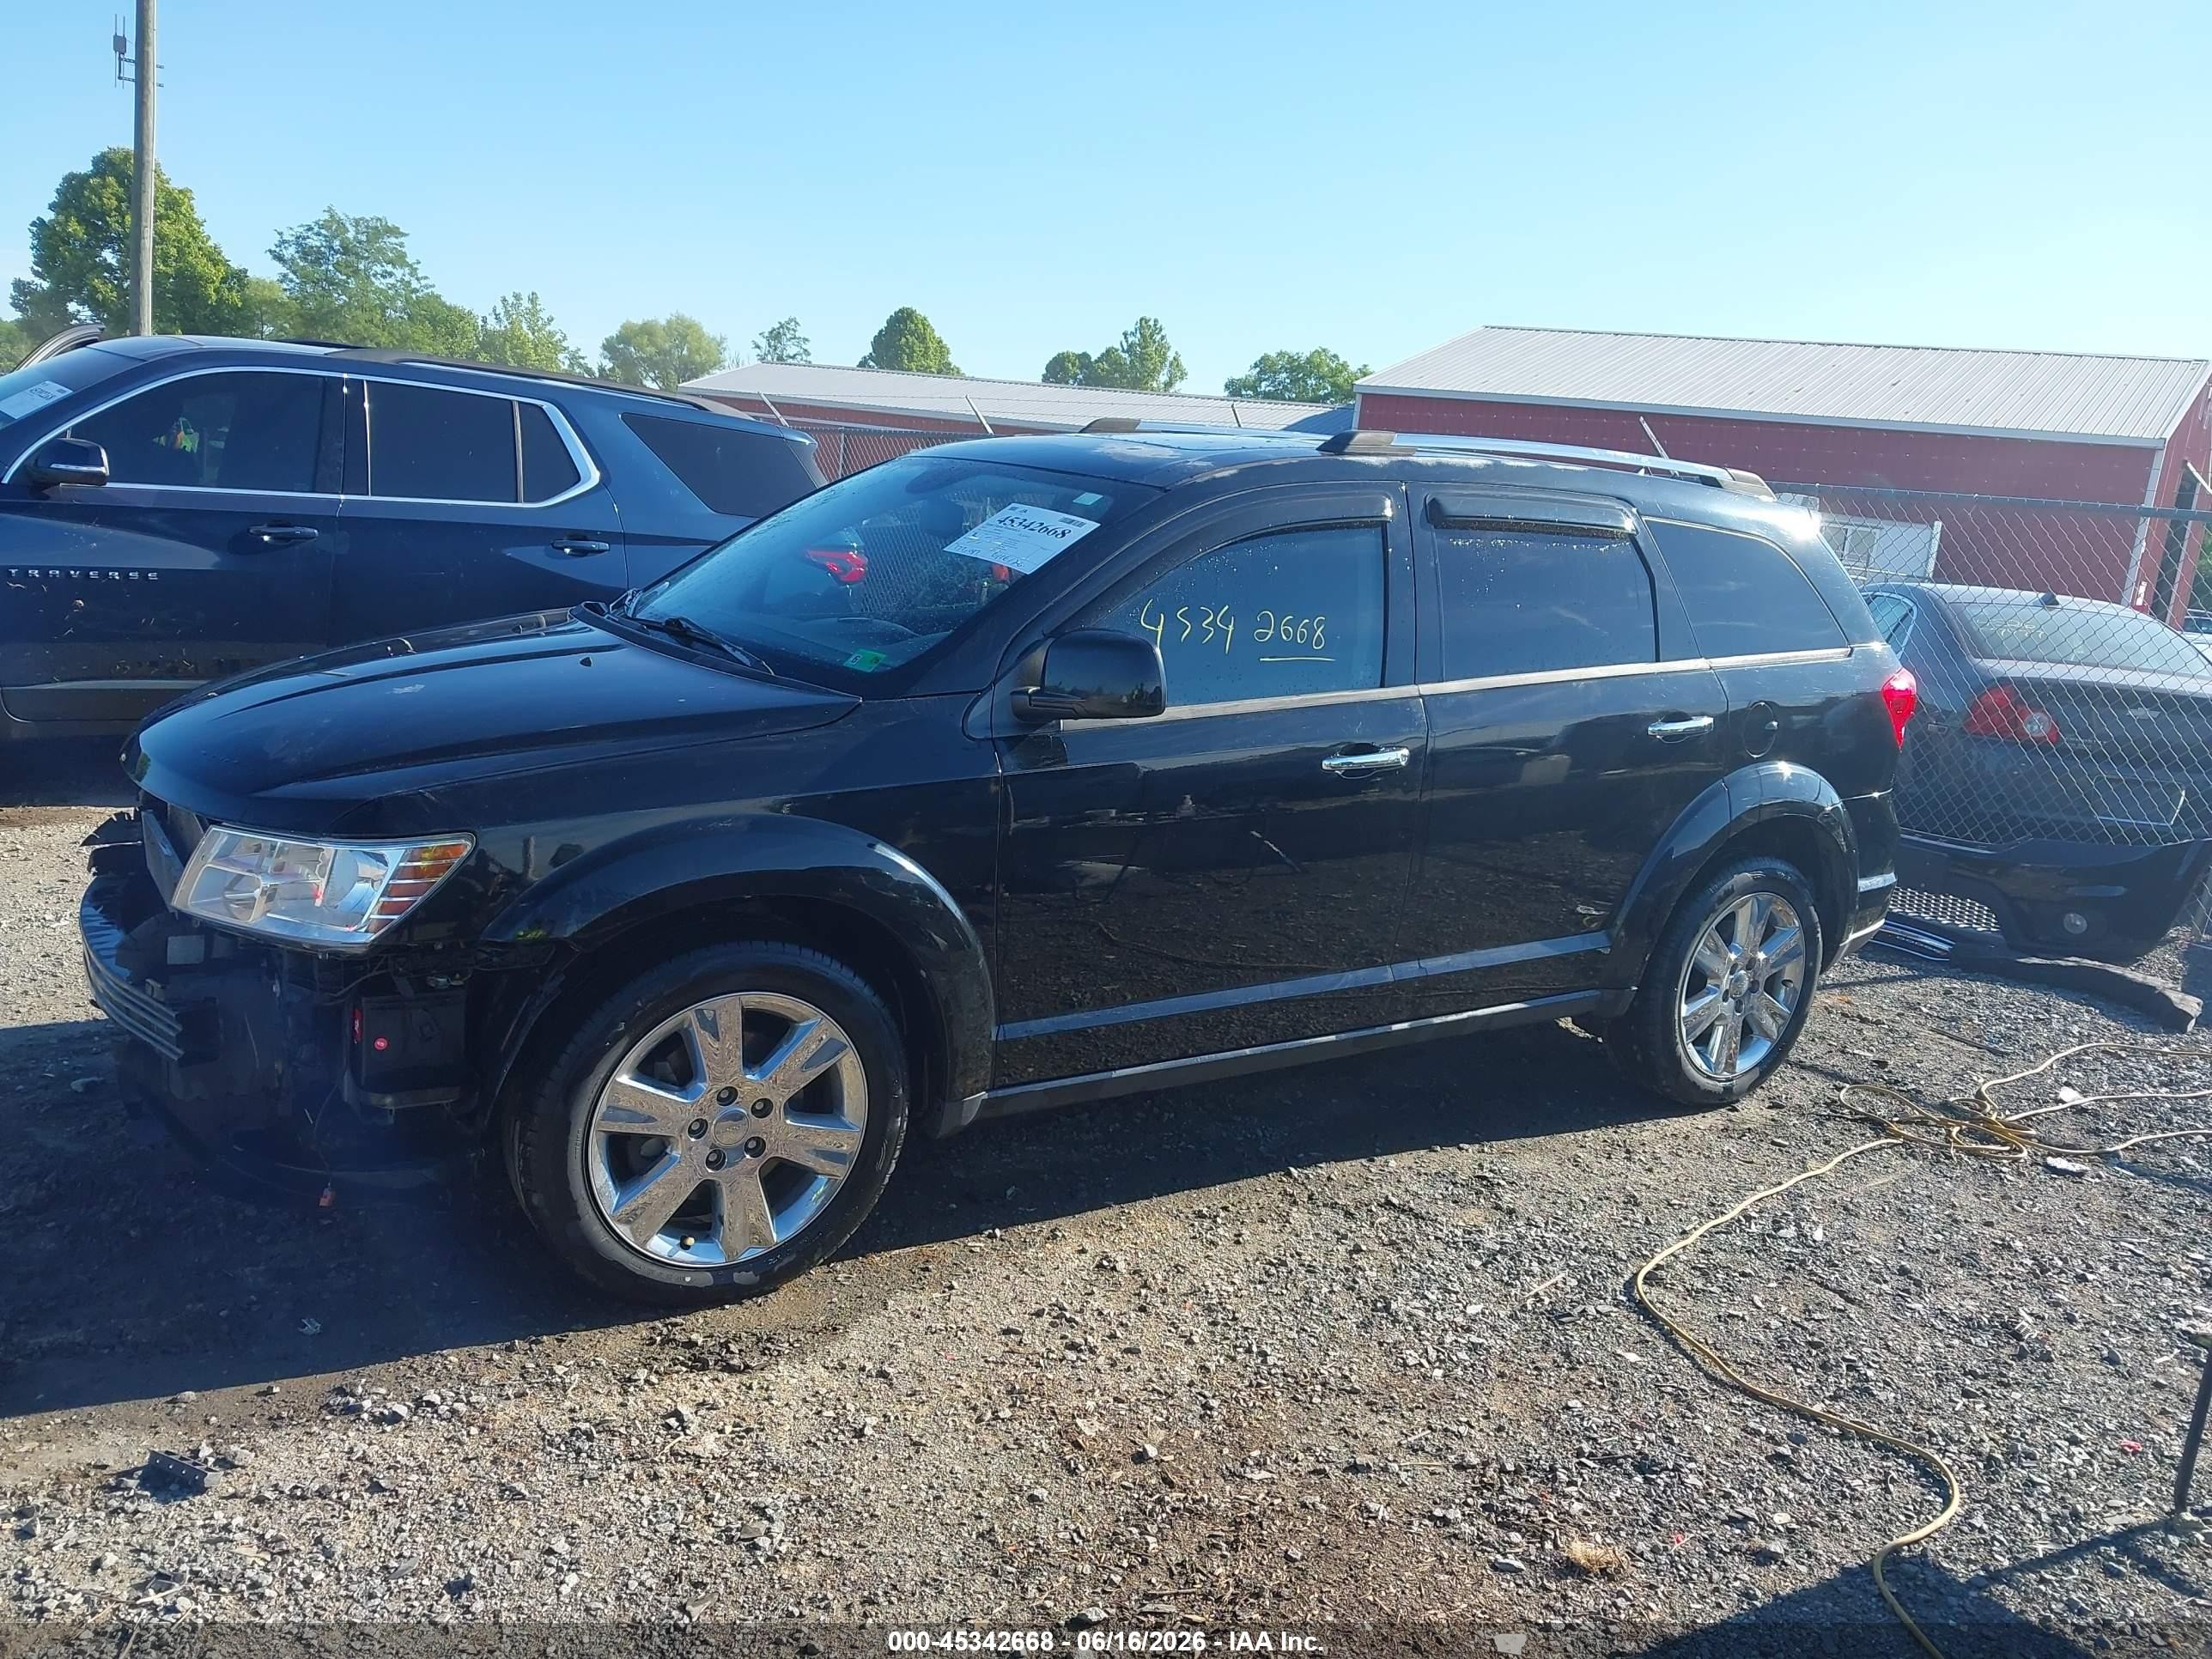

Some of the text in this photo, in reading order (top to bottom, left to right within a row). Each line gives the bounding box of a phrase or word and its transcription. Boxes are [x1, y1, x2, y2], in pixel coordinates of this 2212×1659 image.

[997, 515, 1072, 539] 45342668
[8, 568, 159, 580] TRAVERSE
[1140, 599, 1326, 654] 4534 2668
